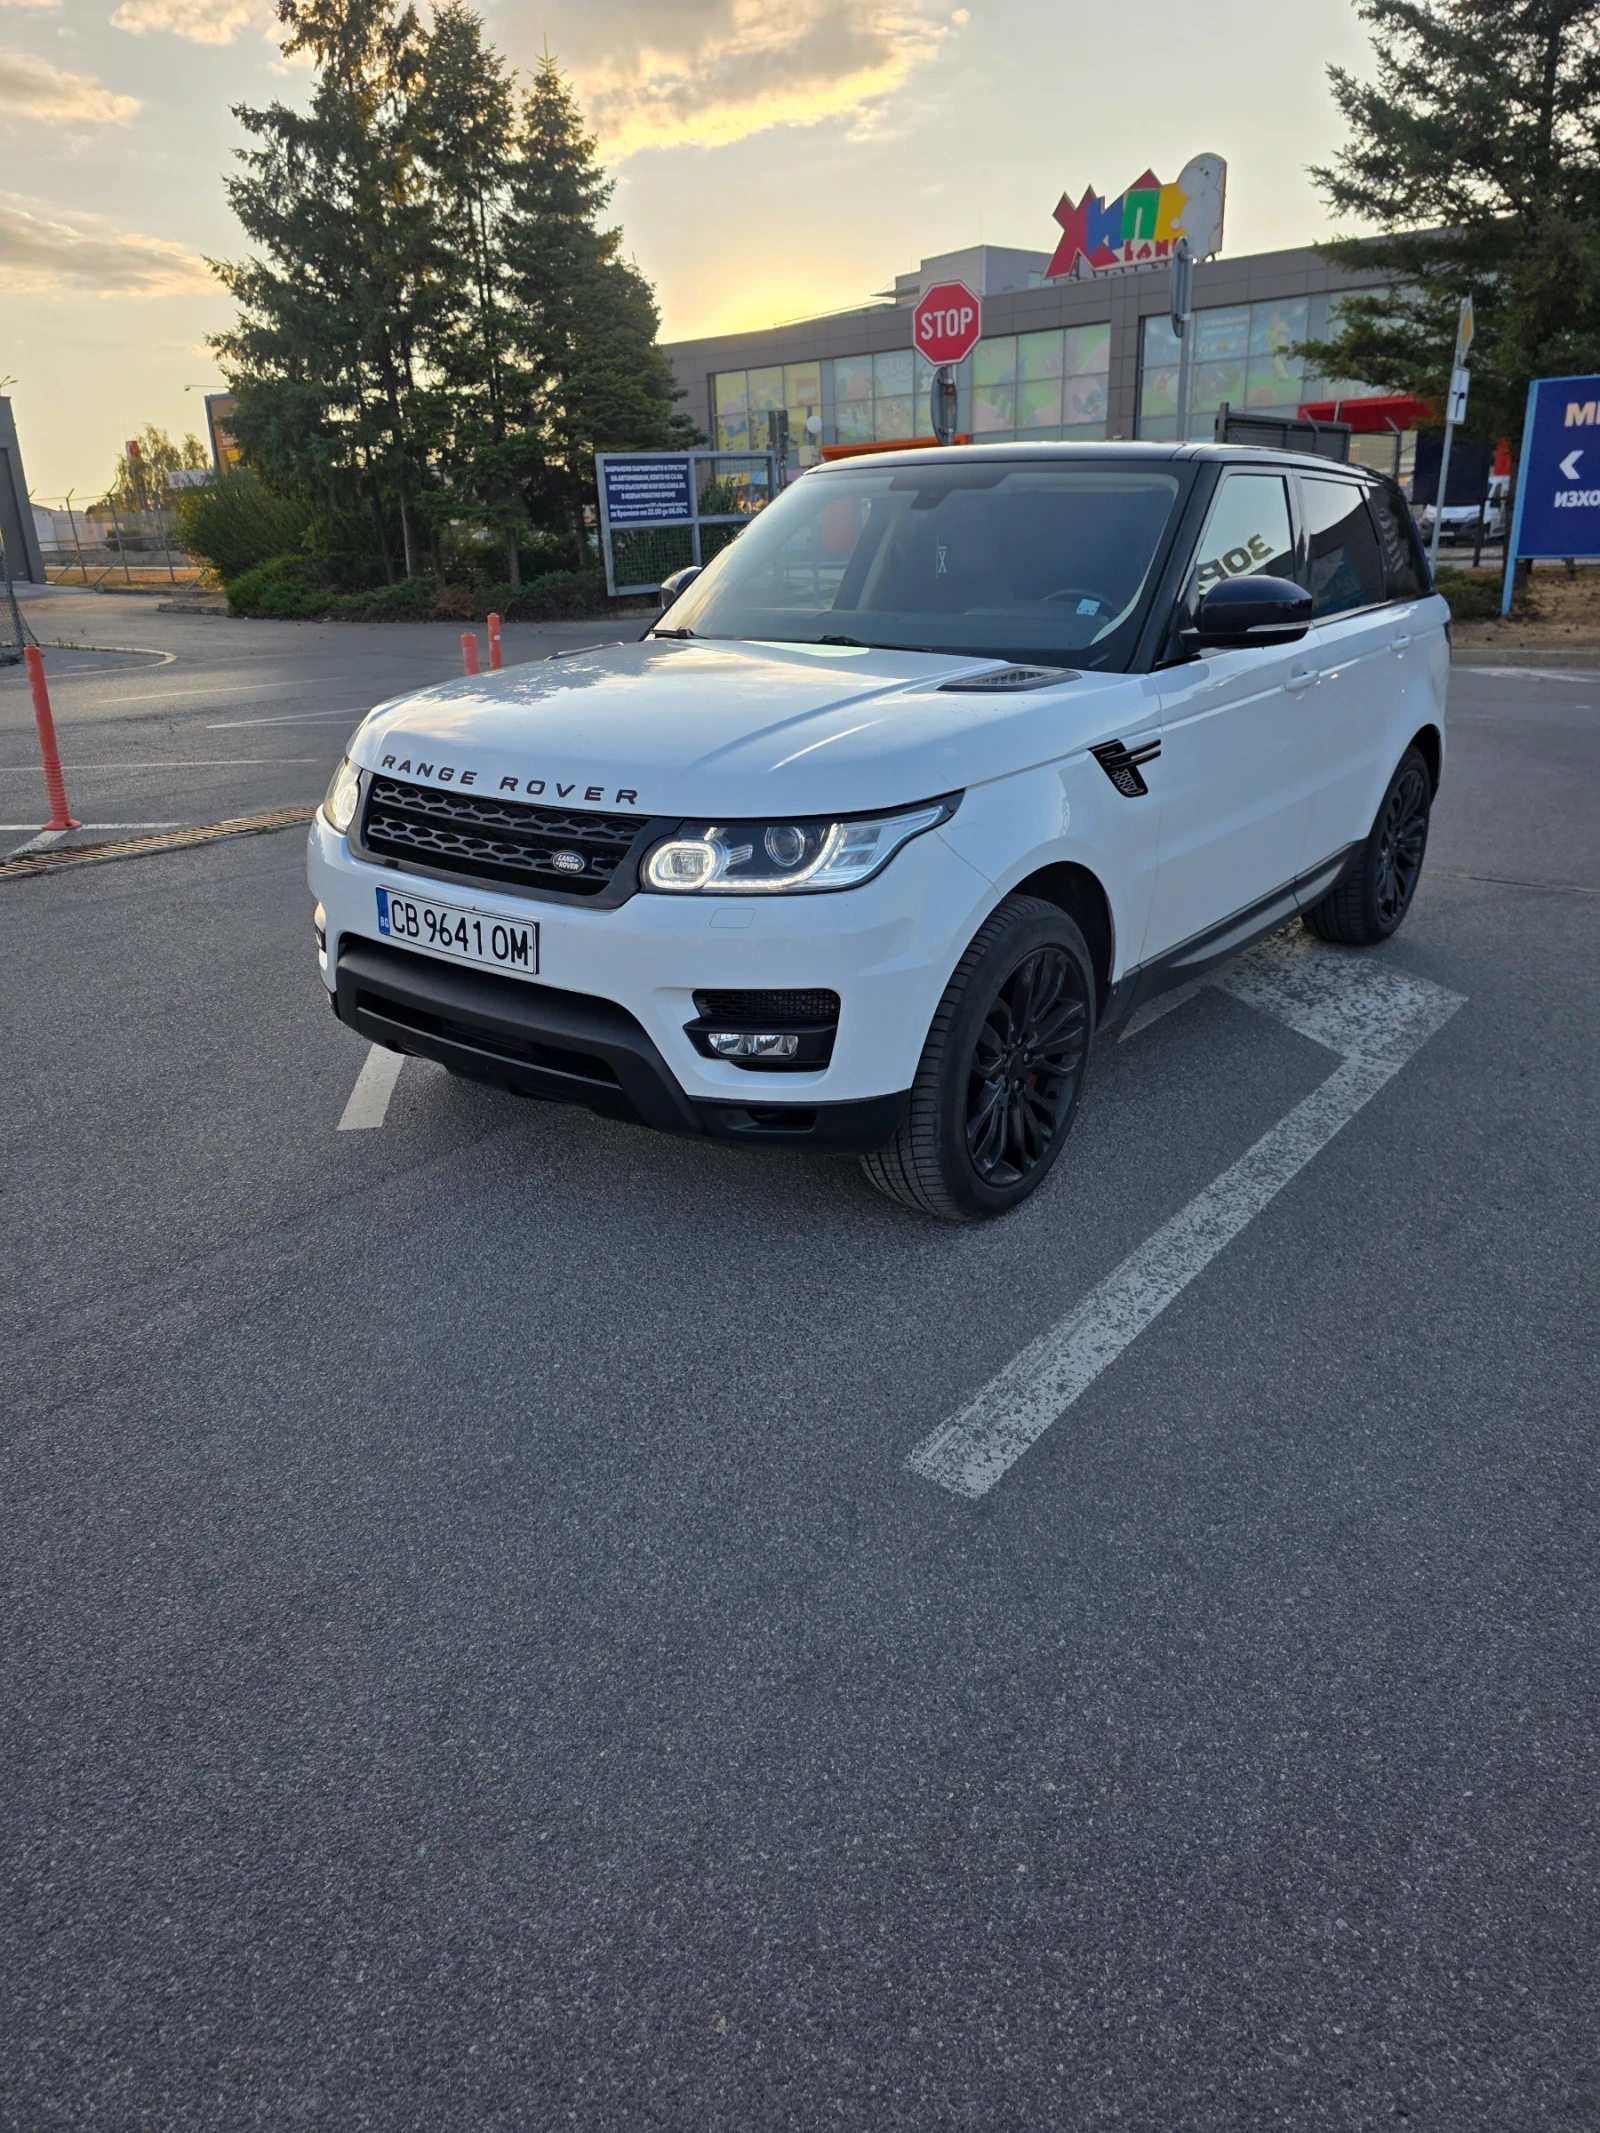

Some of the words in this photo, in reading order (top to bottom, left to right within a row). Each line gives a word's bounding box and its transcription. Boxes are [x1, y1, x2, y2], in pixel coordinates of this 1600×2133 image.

[1124, 238, 1180, 262] LAN
[920, 307, 974, 340] STOP
[1564, 401, 1600, 427] М
[1554, 489, 1600, 508] ИЗХО
[381, 755, 478, 785] RANGE
[499, 776, 639, 804] ROVER
[557, 854, 575, 863] LAND
[558, 861, 580, 871] ROVER
[380, 916, 389, 928] BG
